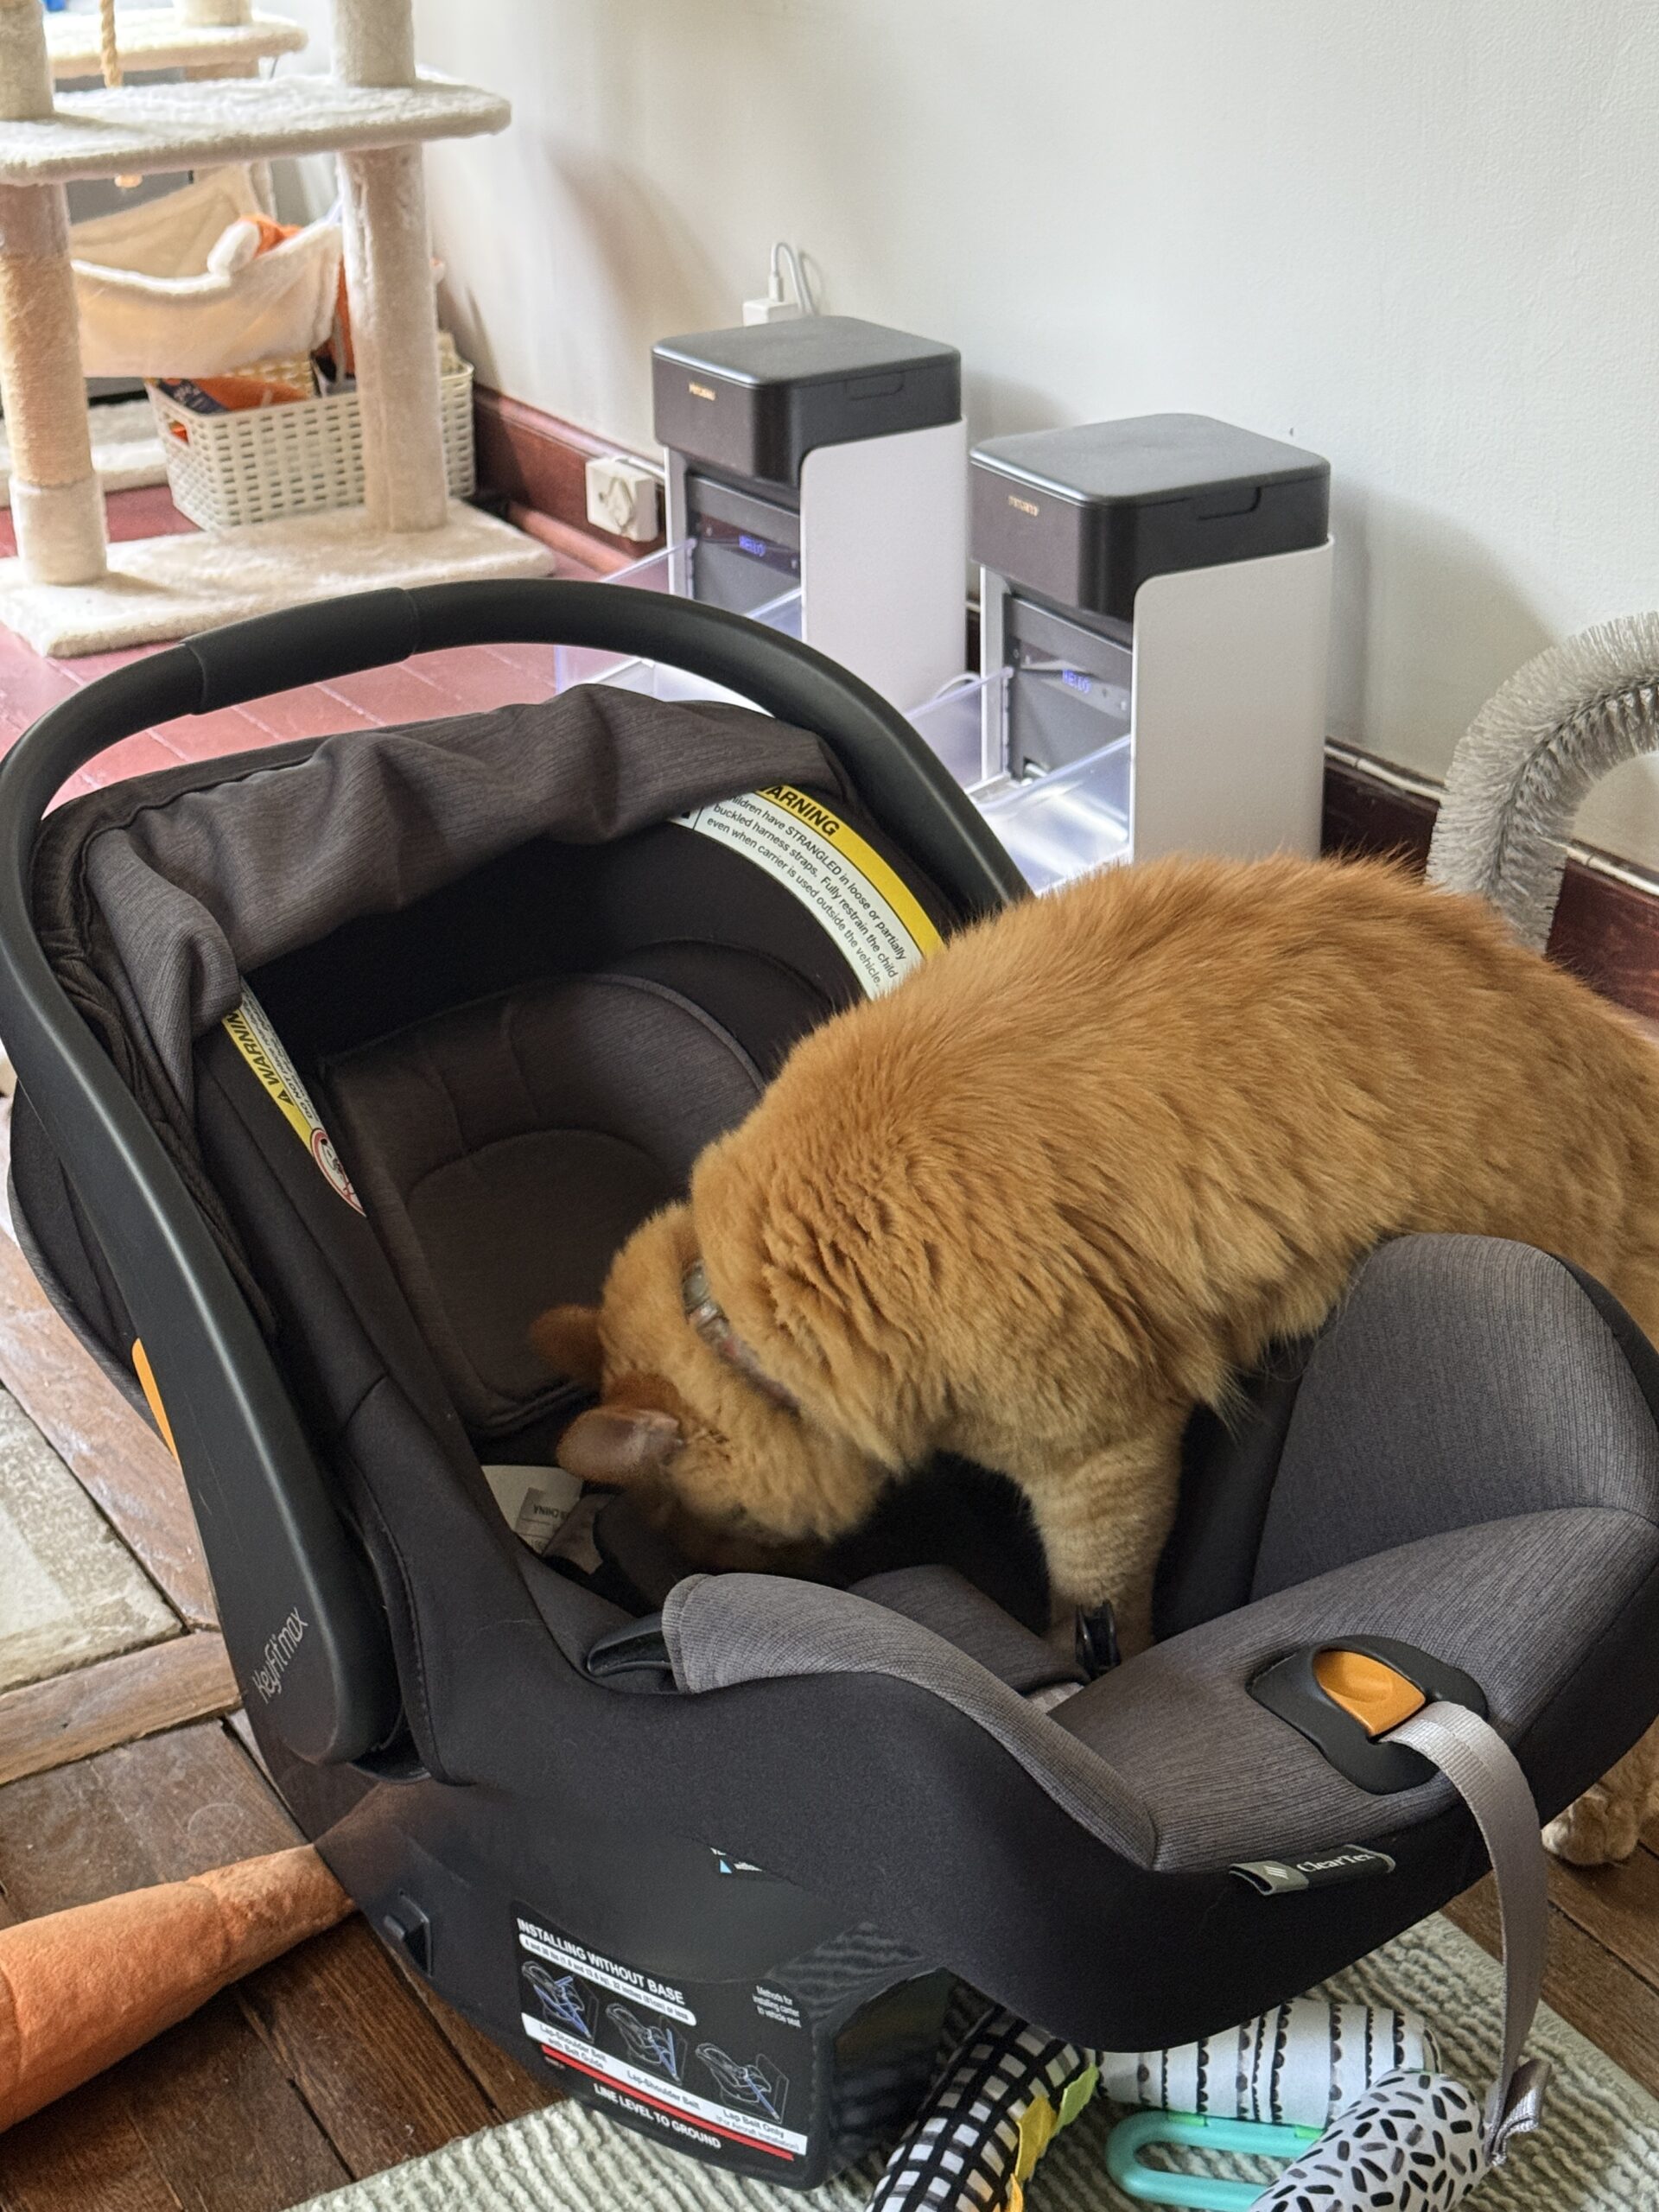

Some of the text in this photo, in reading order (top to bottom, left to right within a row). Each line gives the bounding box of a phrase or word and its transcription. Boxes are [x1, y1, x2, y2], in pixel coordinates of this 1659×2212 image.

[754, 785, 840, 837] ARNING
[706, 817, 881, 987] even when carrier is used outside the vehicle.
[713, 803, 899, 978] buckled harness straps. Fully restrain the child
[729, 795, 907, 962] hildren have STRANGLED in loose or partially
[226, 1013, 280, 1086] WARNIN
[516, 1916, 686, 2006] INSTALLING WITHOUT BASE
[592, 2082, 723, 2150] LINE LEVEL TO GROUND
[723, 2108, 785, 2139] Lap Belt Only
